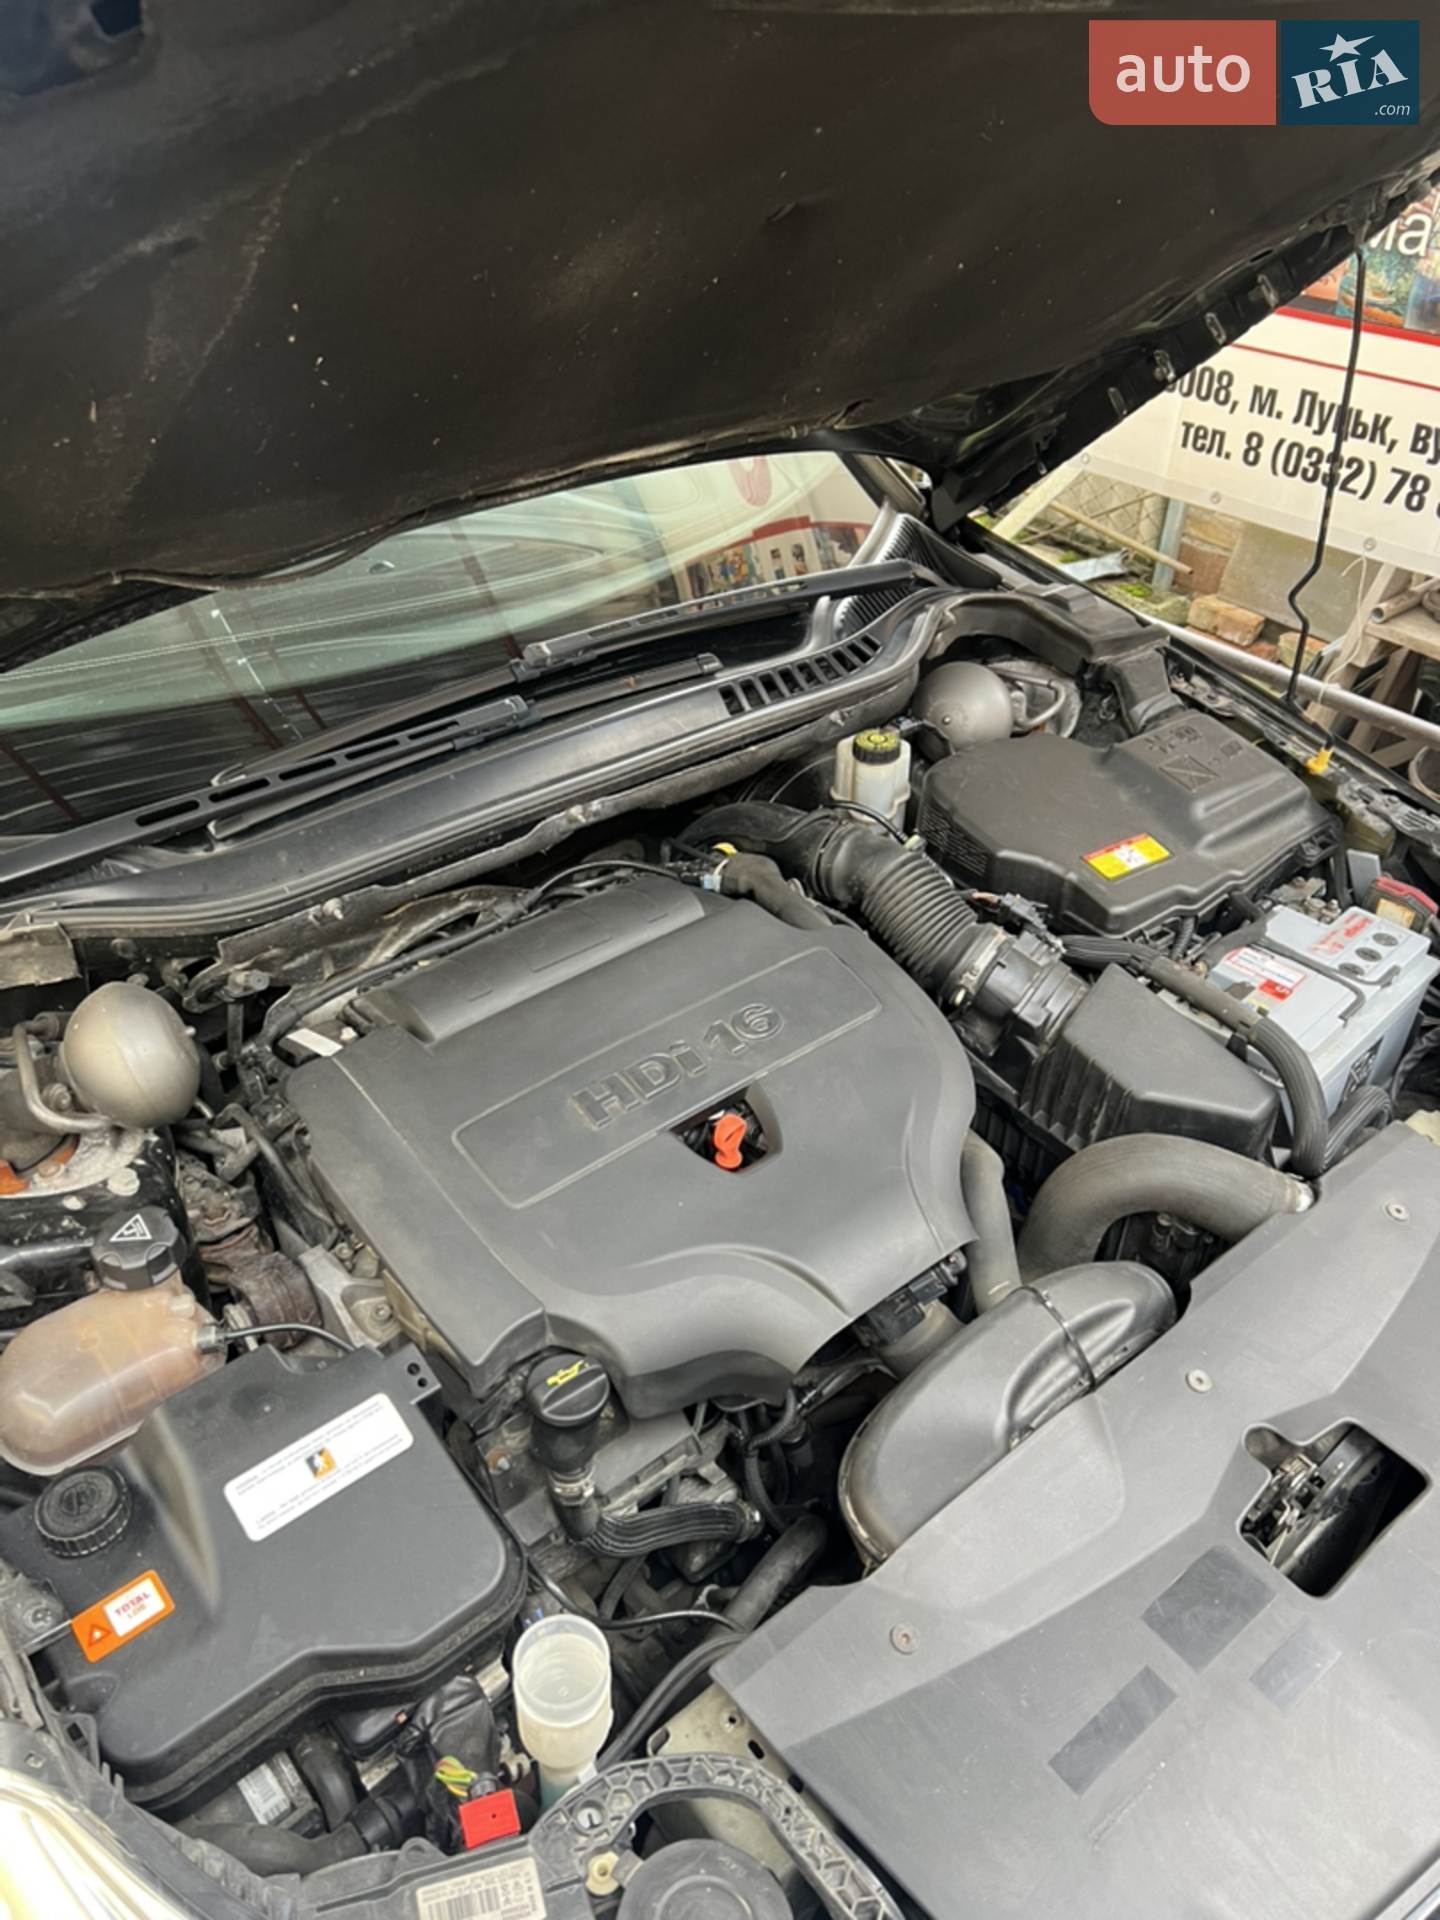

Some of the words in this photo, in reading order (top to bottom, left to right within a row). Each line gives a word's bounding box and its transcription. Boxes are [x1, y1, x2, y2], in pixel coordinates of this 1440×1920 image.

[1164, 366, 1239, 414] 008,
[1249, 384, 1284, 419] м.
[1181, 420, 1231, 460] тел.
[1242, 431, 1264, 467] 8
[1271, 438, 1377, 500] (0332)
[1383, 467, 1431, 512] 78
[114, 1591, 152, 1616] TOTAL
